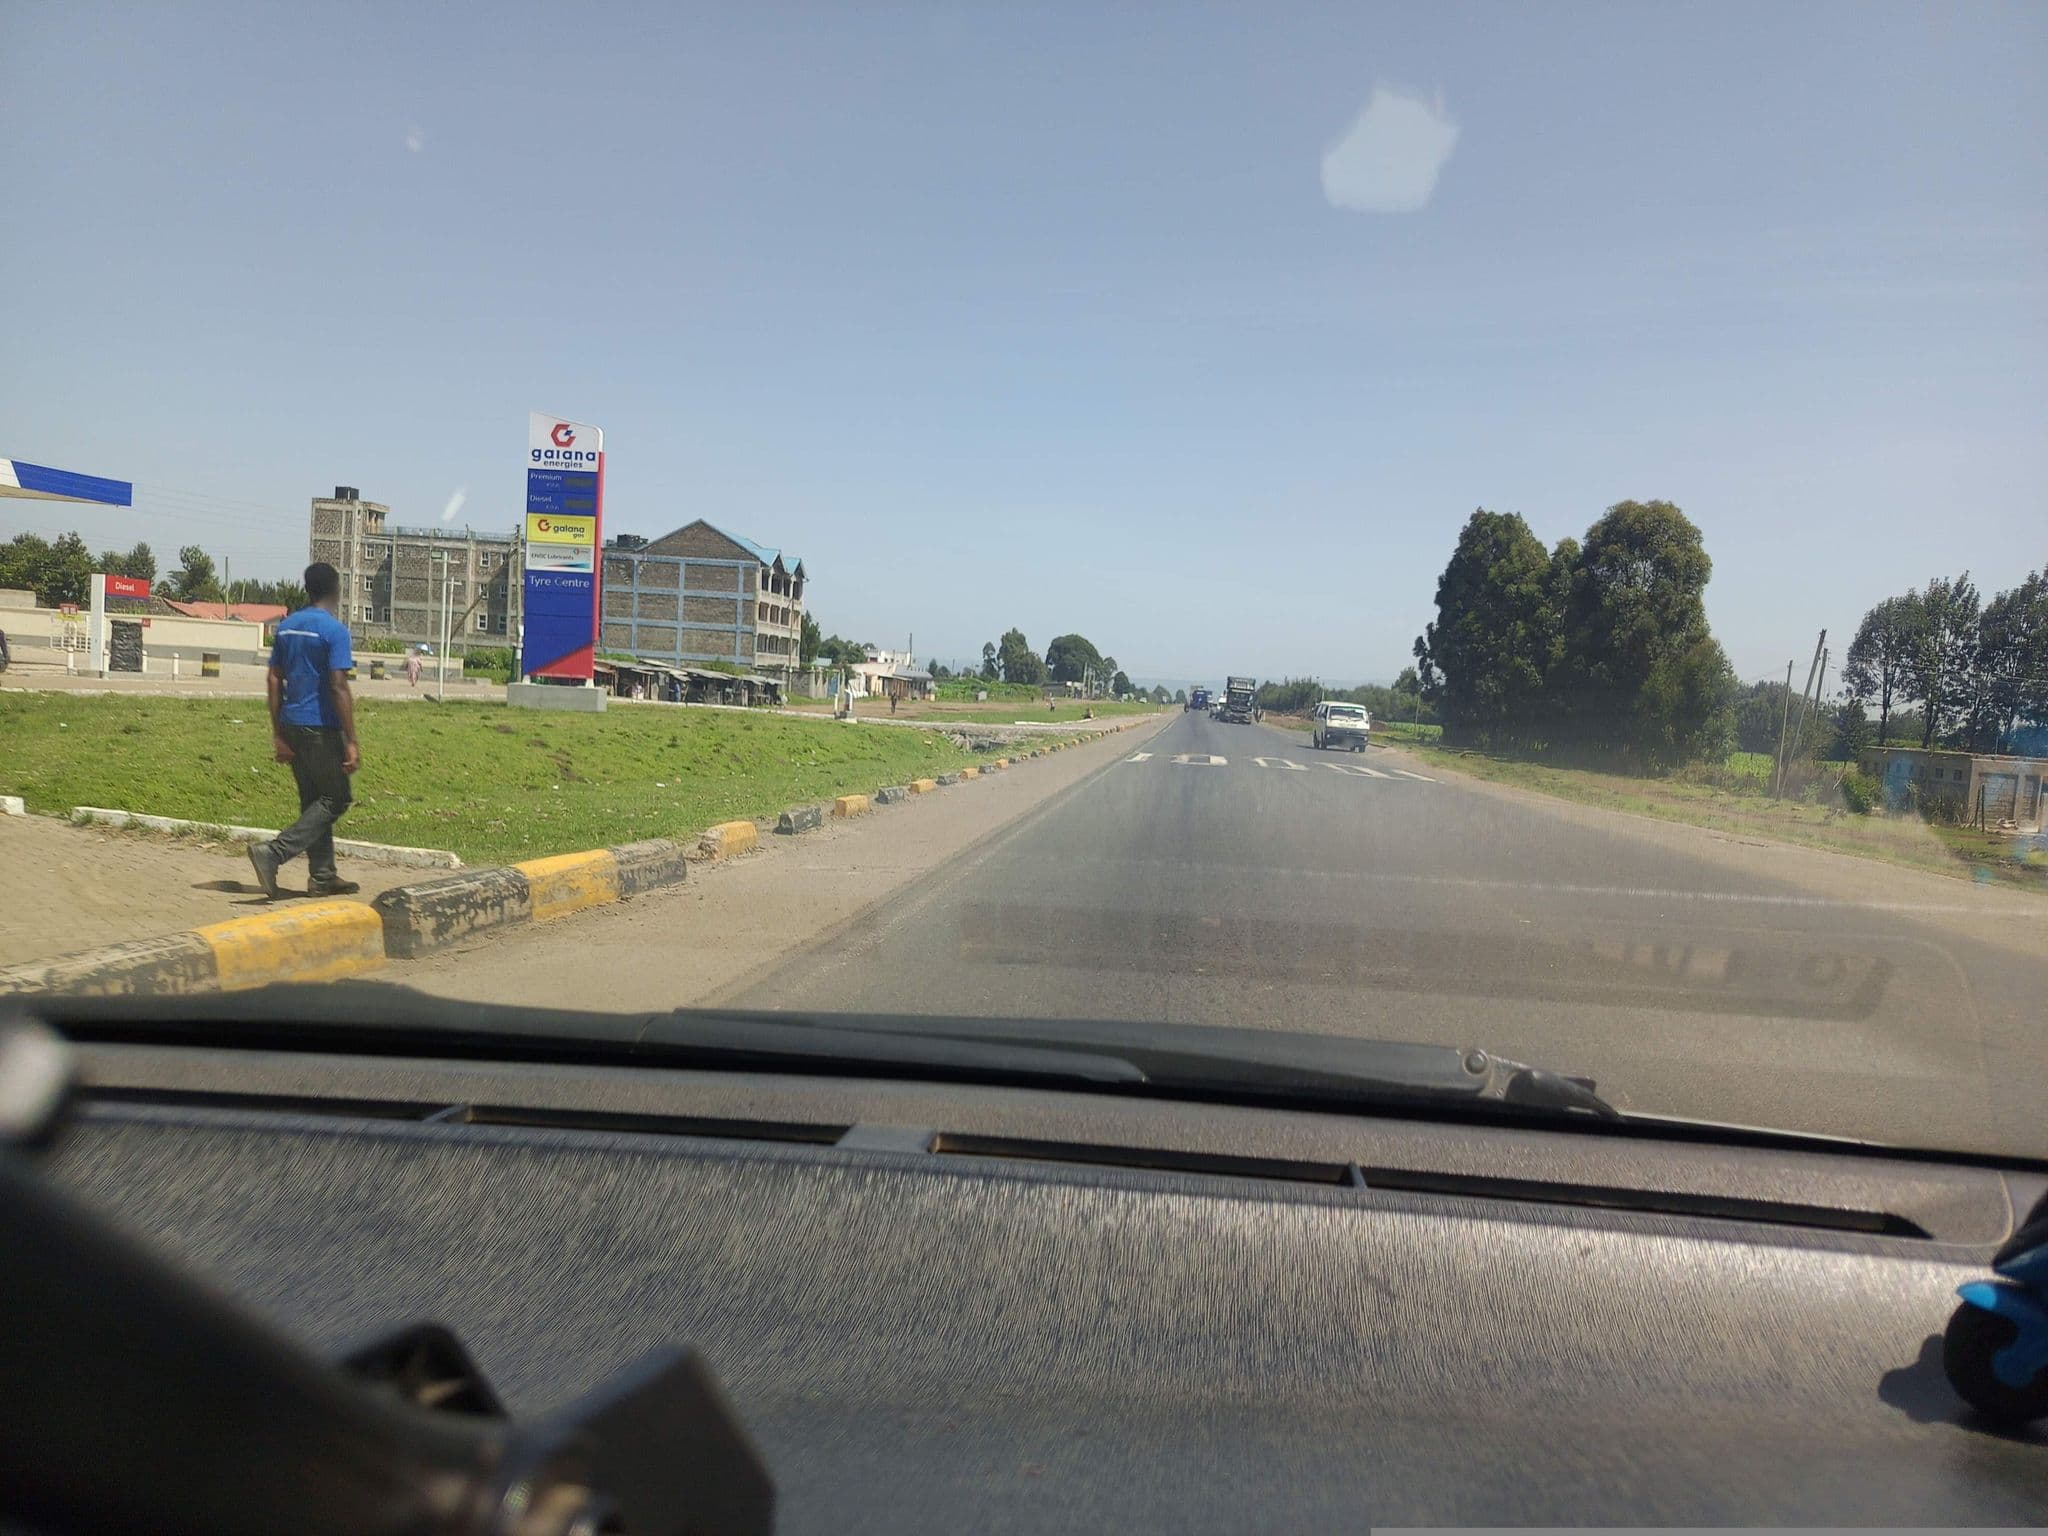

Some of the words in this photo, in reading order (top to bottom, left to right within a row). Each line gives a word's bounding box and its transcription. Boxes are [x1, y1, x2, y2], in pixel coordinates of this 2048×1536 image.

[543, 460, 583, 468] energies
[530, 472, 562, 481] Premium
[530, 495, 552, 503] Diesel
[553, 525, 585, 534] galana
[529, 575, 551, 587] Tyre
[554, 577, 590, 588] Centre
[115, 581, 135, 592] Diesel
